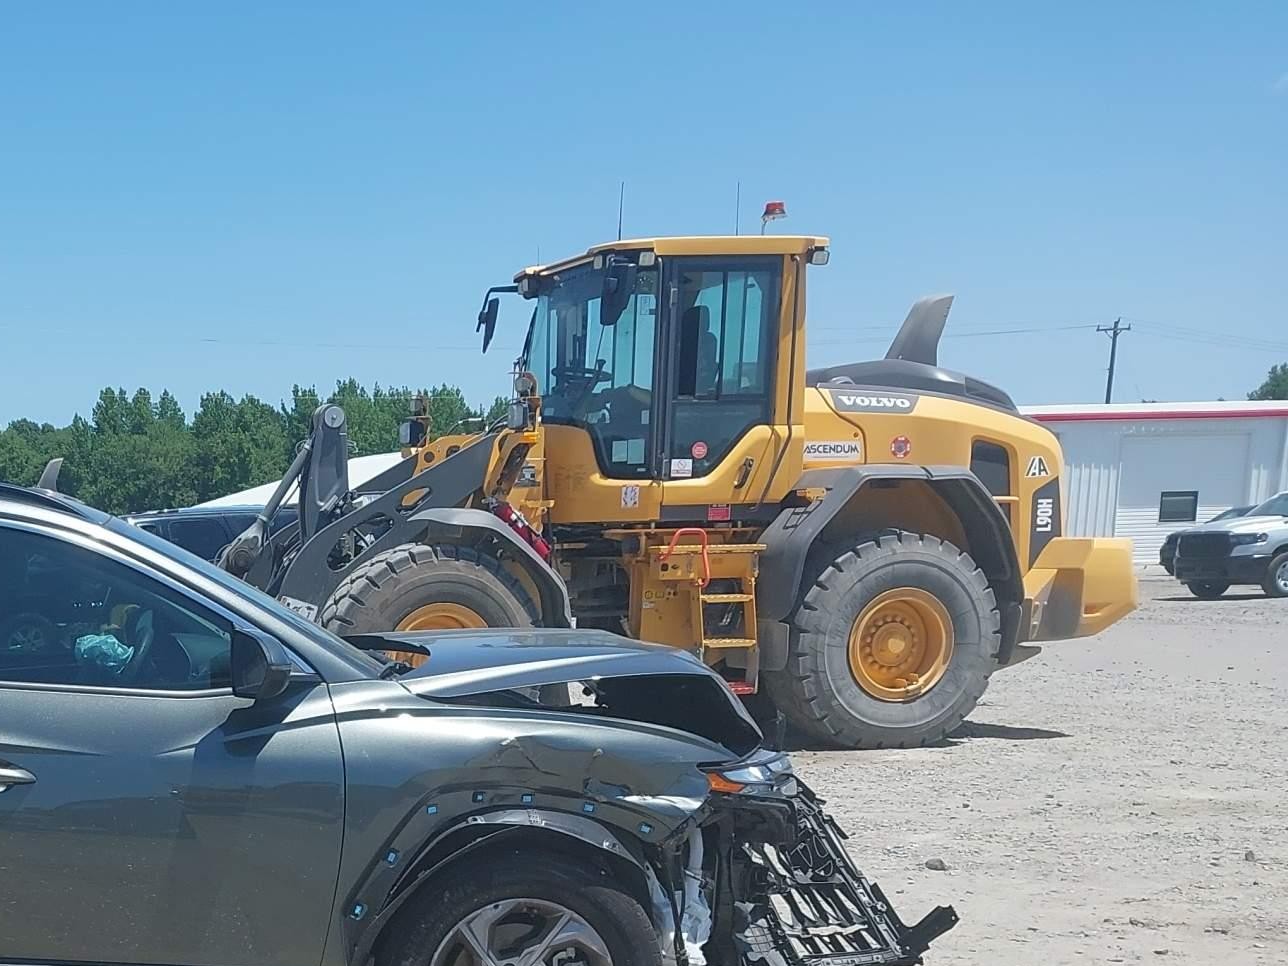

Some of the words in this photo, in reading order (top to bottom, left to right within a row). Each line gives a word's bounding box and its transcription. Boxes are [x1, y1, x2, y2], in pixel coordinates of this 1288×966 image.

[837, 395, 911, 408] VOLVO
[803, 444, 860, 454] ASCENDUM
[1036, 498, 1053, 532] L90H
